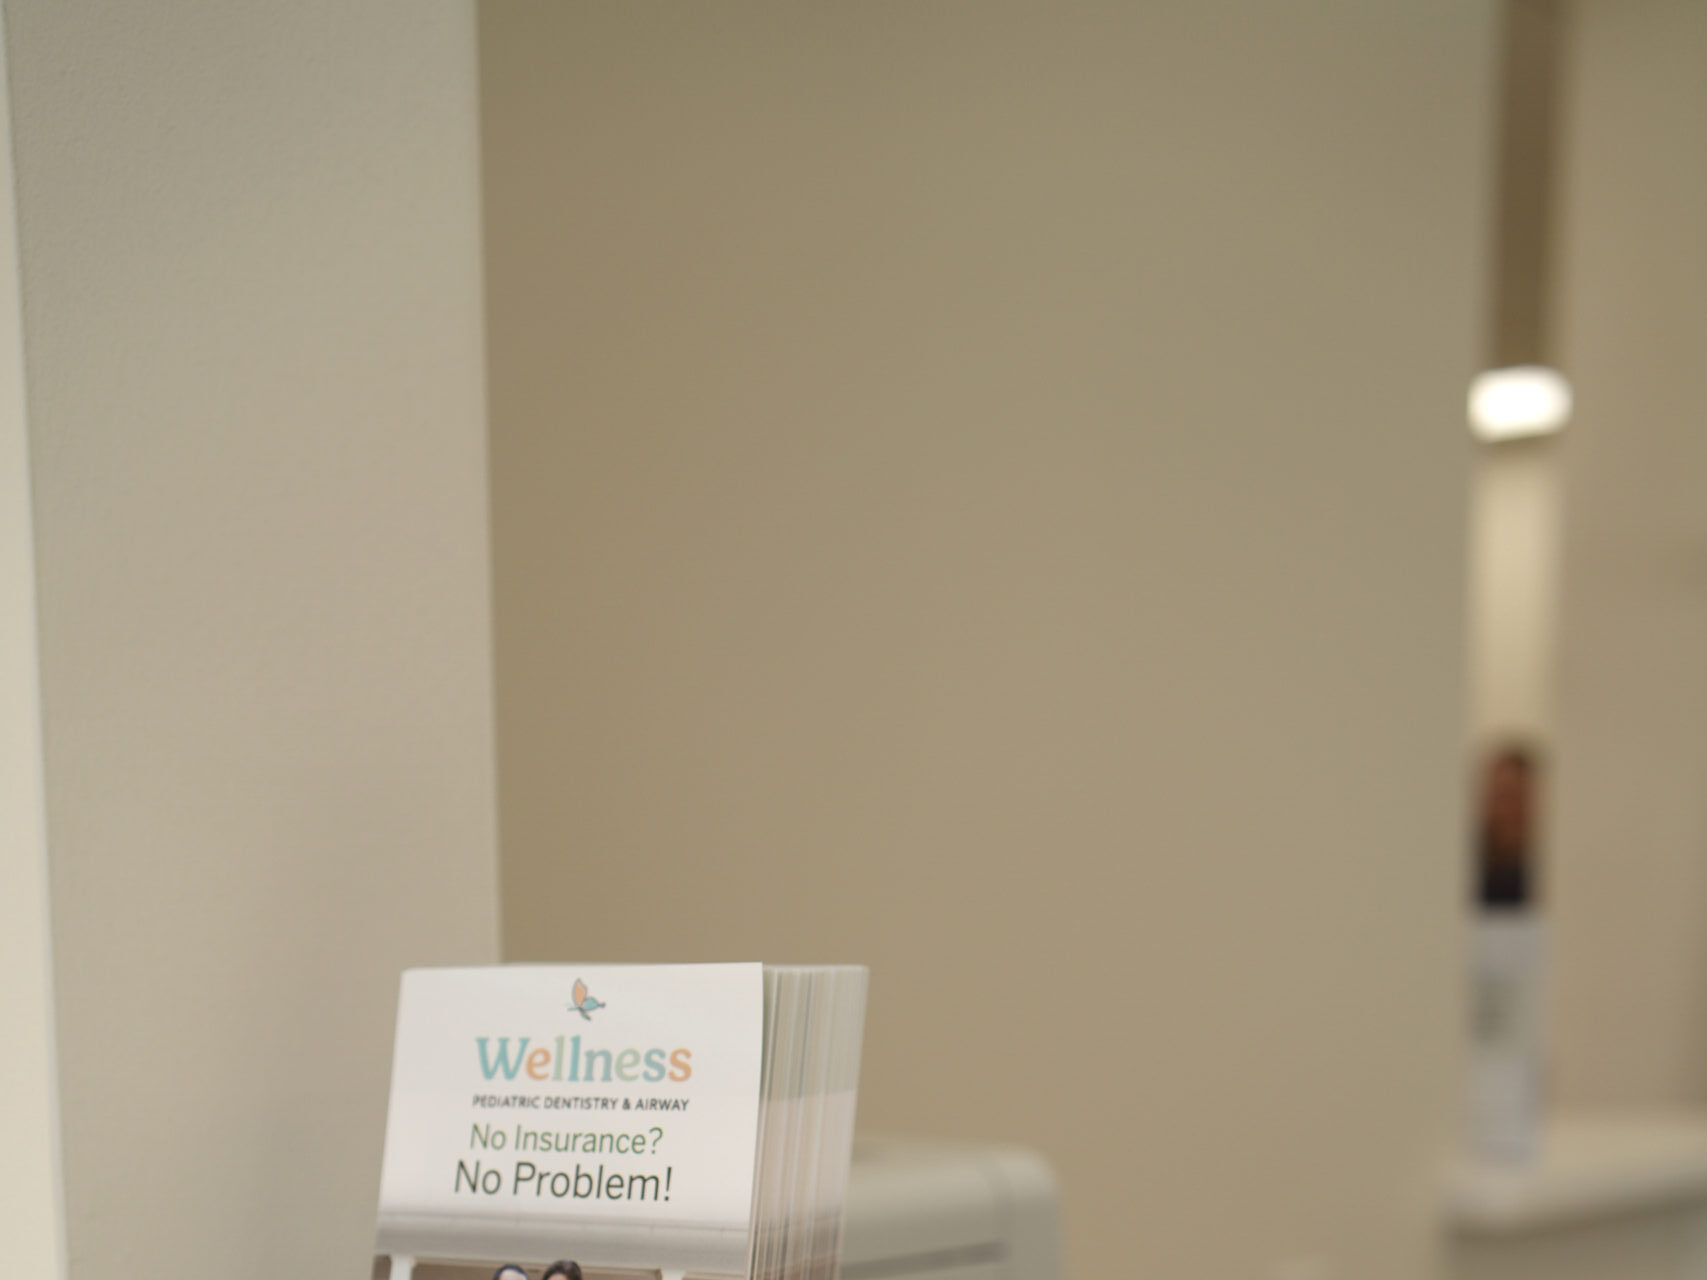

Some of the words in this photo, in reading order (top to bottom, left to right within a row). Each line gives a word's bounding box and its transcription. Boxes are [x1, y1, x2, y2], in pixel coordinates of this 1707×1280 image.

[475, 1035, 693, 1082] Wellness
[472, 1094, 541, 1109] PEDIATRIC
[543, 1096, 618, 1111] DENTISTRY
[622, 1097, 631, 1111] &
[634, 1098, 690, 1112] AIRWAY
[470, 1123, 507, 1150] No
[514, 1124, 664, 1155] Insurance?
[454, 1159, 502, 1196] No
[513, 1161, 673, 1201] Problem!
